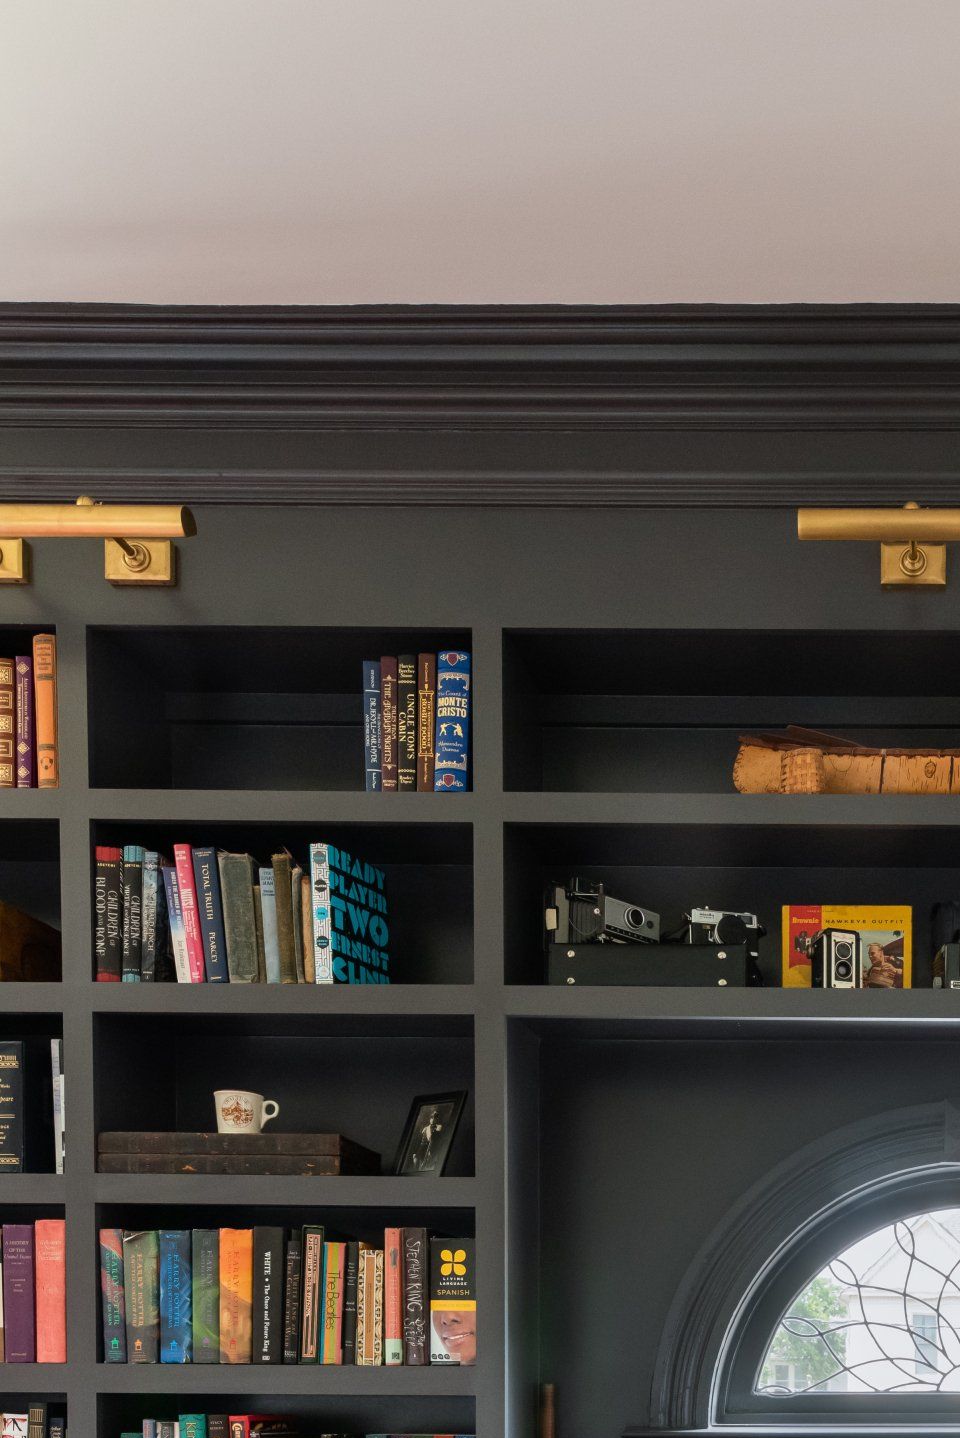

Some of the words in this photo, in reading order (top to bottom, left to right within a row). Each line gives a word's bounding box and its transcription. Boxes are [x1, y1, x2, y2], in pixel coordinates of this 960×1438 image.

[407, 694, 416, 727] UNCLE
[438, 697, 467, 707] MONTE
[438, 707, 467, 718] CRISTO
[383, 736, 391, 763] NIGHTS
[407, 731, 416, 759] TOM'S
[201, 864, 210, 890] TOTAL
[328, 844, 386, 891] READY
[96, 877, 106, 913] BLOOD
[204, 892, 214, 920] TRUTH
[329, 867, 388, 915] PLAYER
[107, 890, 118, 938] CHILDREN
[131, 895, 141, 939] CHILDREN
[330, 894, 389, 948] TWO
[96, 927, 106, 957] BONE
[208, 932, 218, 963] PEARCEY
[331, 930, 389, 972] ERNEST
[111, 1252, 120, 1284] HARRY
[232, 1251, 240, 1287] HARRY
[405, 1238, 421, 1282] STEPHEN
[327, 1271, 340, 1291] The
[326, 1292, 340, 1330] Beatles
[405, 1283, 423, 1312] KING
[262, 1339, 271, 1352] King
[404, 1318, 416, 1347] SLEEP
